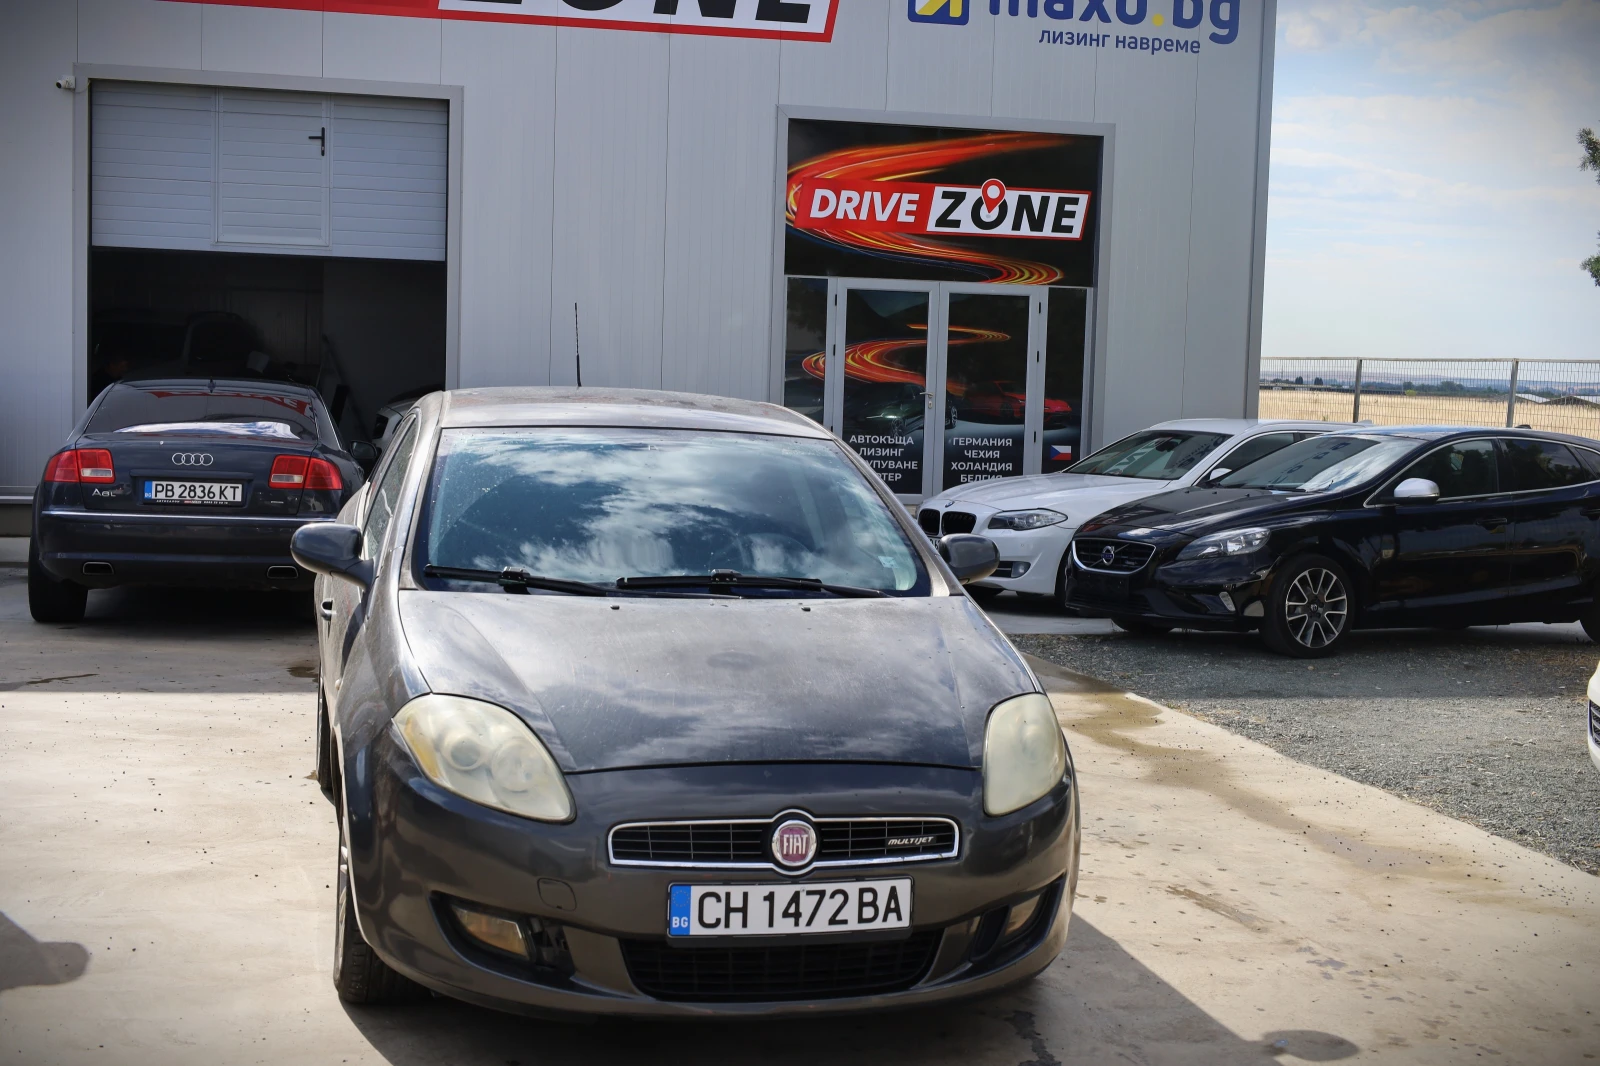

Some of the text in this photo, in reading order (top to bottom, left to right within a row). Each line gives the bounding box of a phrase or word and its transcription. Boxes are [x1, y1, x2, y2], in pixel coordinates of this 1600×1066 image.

[1039, 30, 1201, 55] лизинг навреме
[809, 188, 1080, 234] DRIVE ZONE
[849, 434, 914, 446] АВТОКЪЩА
[953, 437, 1013, 447] ГЕРМАНИЯ
[859, 447, 905, 457] ЛИЗИНГ
[964, 449, 1000, 459] ЧЕХИЯ
[951, 461, 1013, 472] ХОЛАНДИЯ
[154, 483, 240, 501] PB 2836 KT
[783, 833, 809, 855] FIAT
[887, 836, 934, 846] MULTIJET
[698, 885, 904, 929] CH 1472 BA
[672, 916, 689, 929] BG
